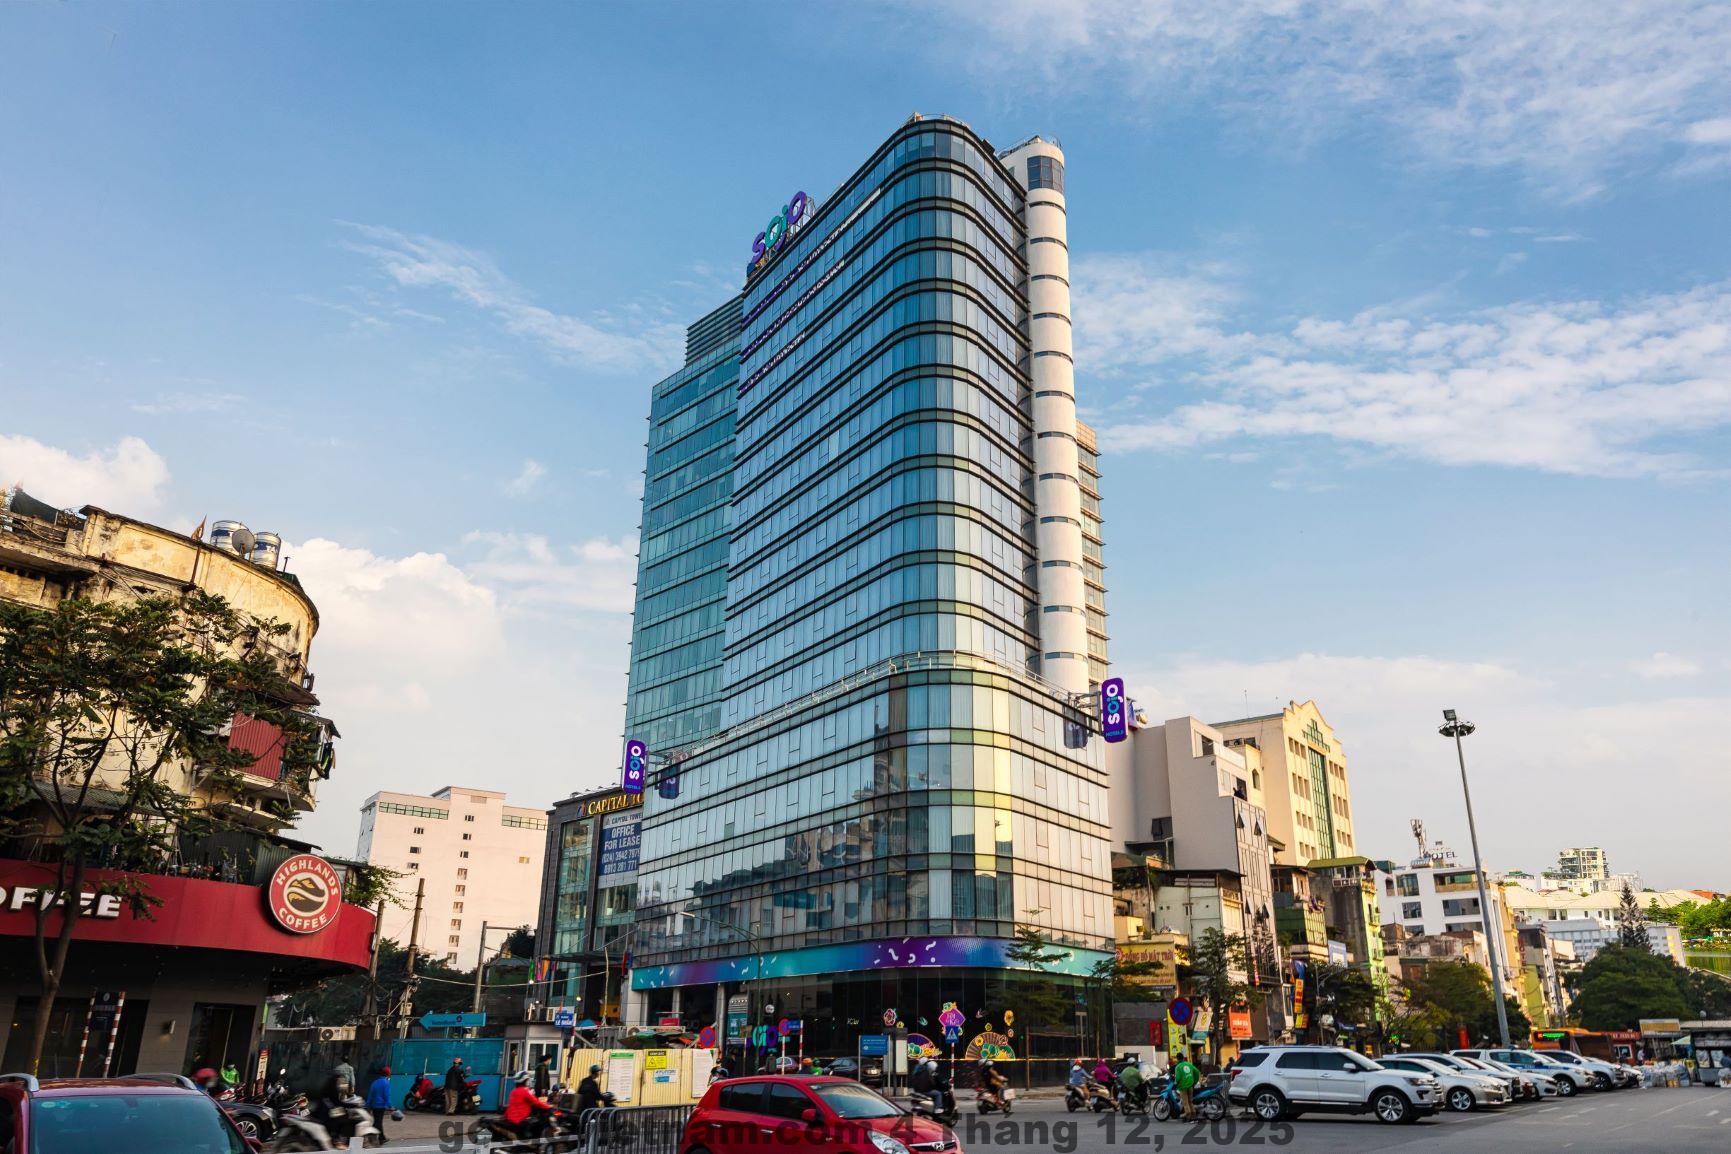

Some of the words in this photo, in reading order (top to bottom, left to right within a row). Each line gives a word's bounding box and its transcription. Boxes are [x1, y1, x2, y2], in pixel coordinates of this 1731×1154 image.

[588, 795, 629, 815] CAPITAL
[611, 825, 635, 838] OFFICE
[604, 839, 617, 850] FOR
[619, 835, 641, 848] LEASE
[276, 859, 339, 896] HIGHLANDS
[278, 907, 328, 930] COFFEE
